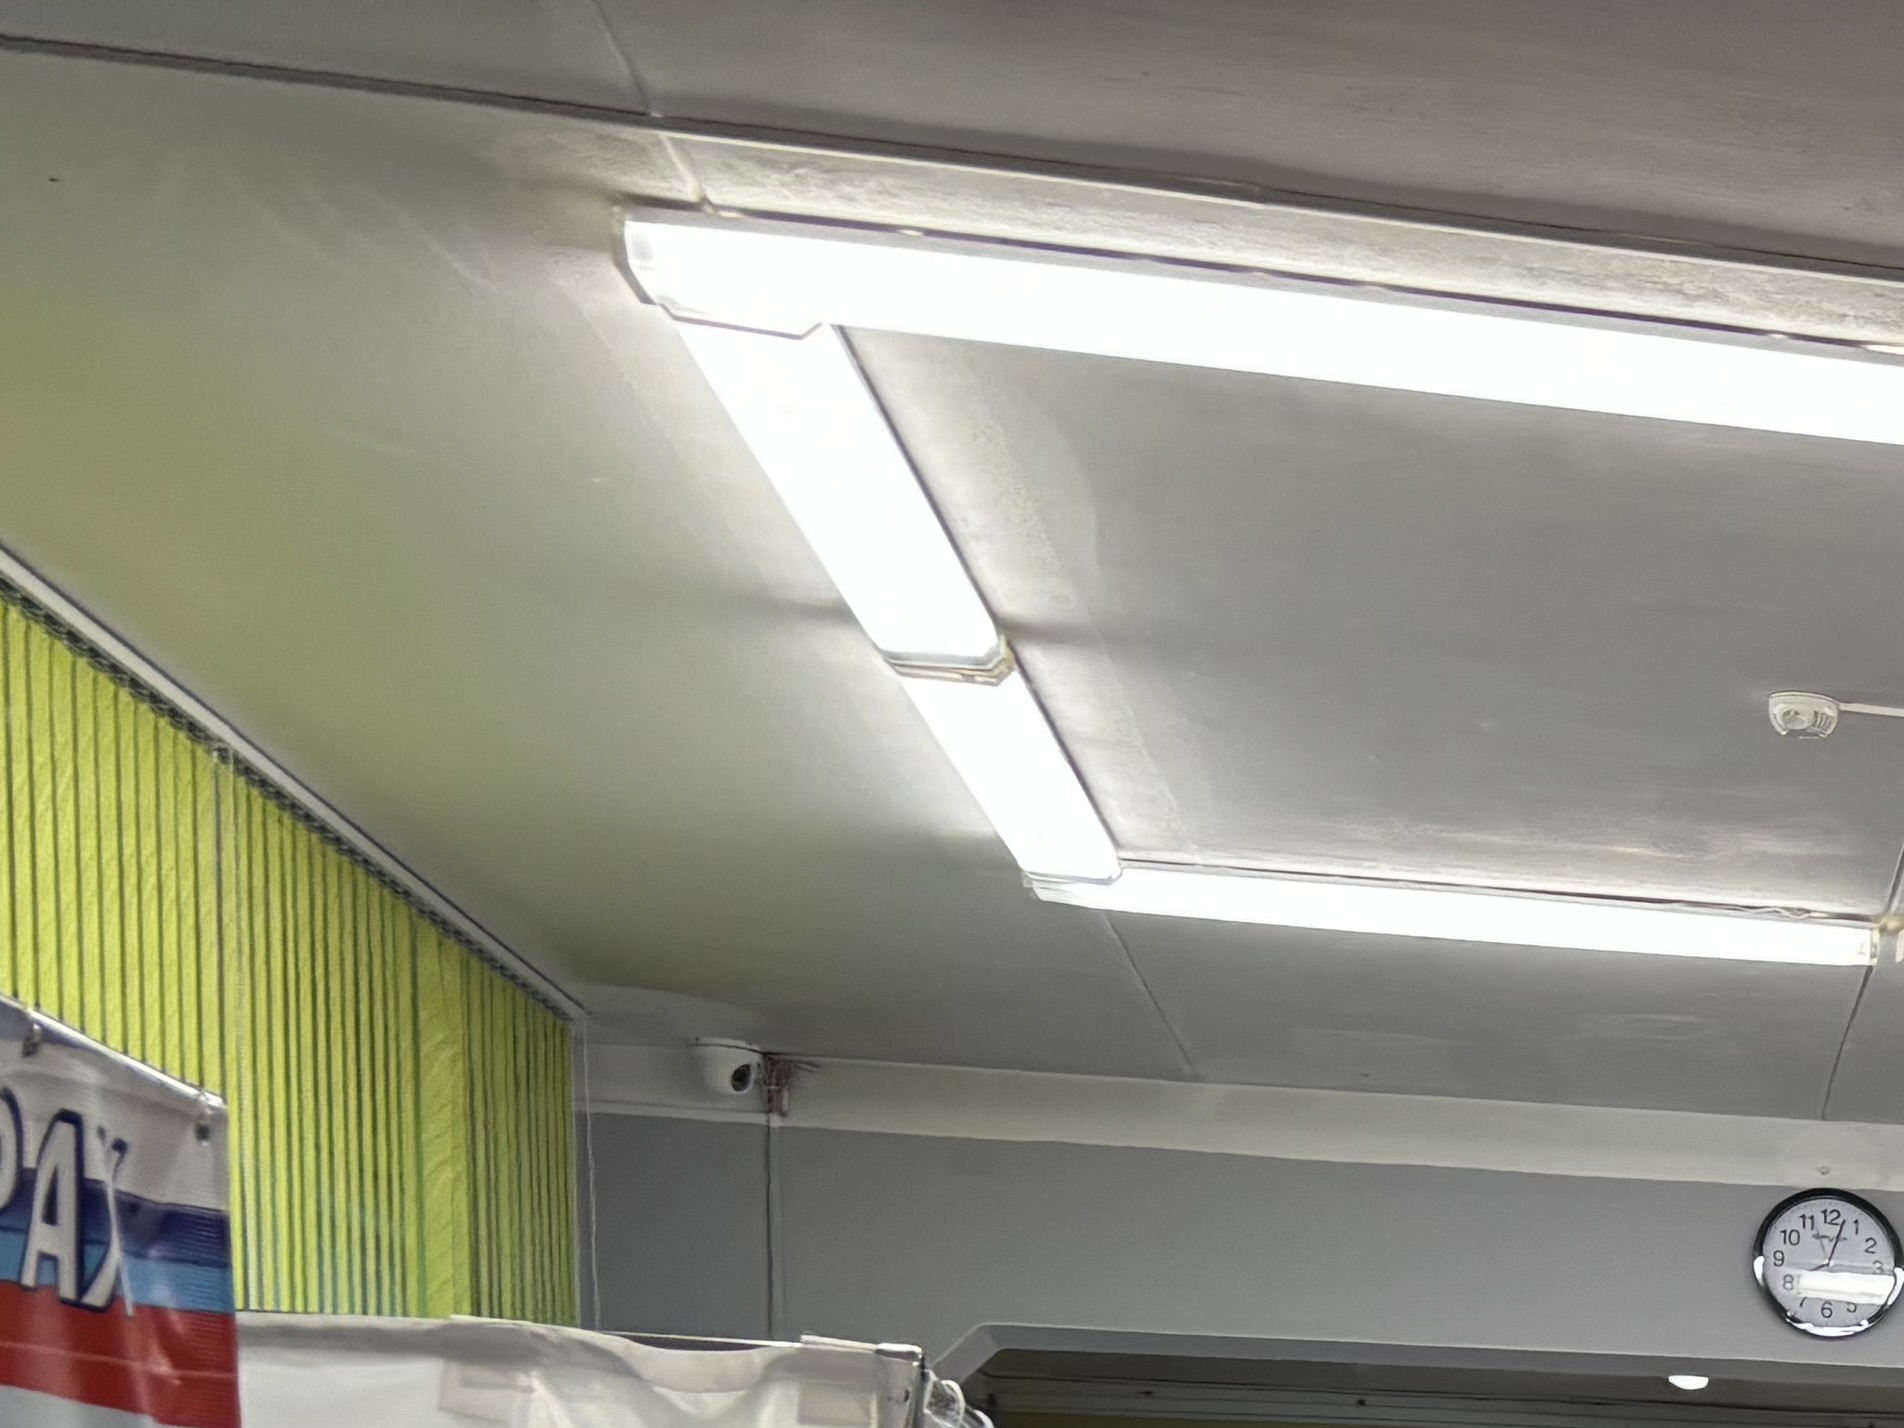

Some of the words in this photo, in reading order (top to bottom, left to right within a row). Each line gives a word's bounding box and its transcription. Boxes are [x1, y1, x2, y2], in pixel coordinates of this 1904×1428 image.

[1800, 1214, 1815, 1231] 11
[1821, 1209, 1841, 1226] 12
[1853, 1219, 1860, 1235] 1
[1780, 1229, 1800, 1246] 10
[1864, 1237, 1877, 1254] 2
[1773, 1250, 1785, 1267] 9
[1783, 1274, 1794, 1291] 8
[1821, 1301, 1833, 1318] 6
